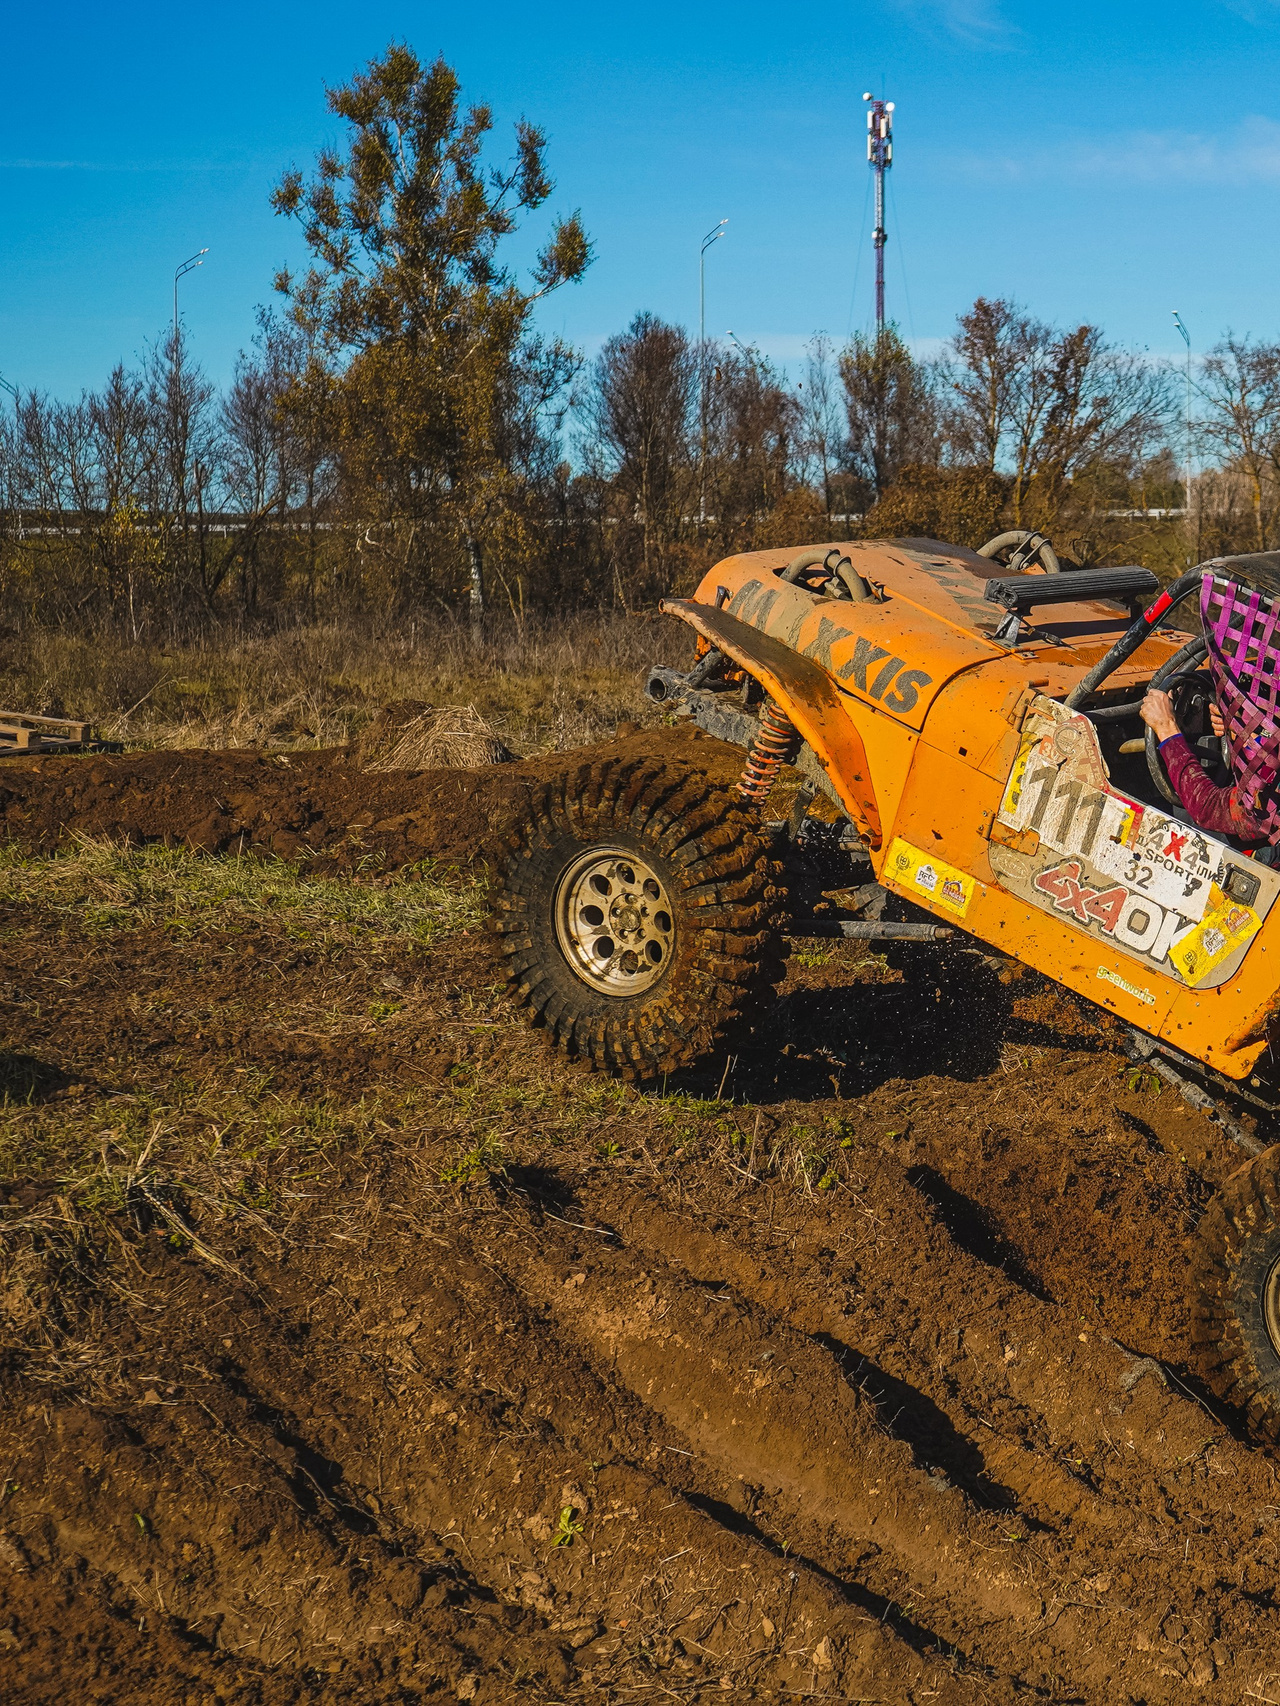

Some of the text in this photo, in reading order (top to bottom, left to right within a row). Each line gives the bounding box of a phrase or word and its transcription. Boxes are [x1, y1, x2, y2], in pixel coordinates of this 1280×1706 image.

[727, 579, 933, 713] MXXIS
[1029, 766, 1107, 856] 111
[1123, 859, 1153, 890] 32
[1144, 848, 1194, 881] SPORT
